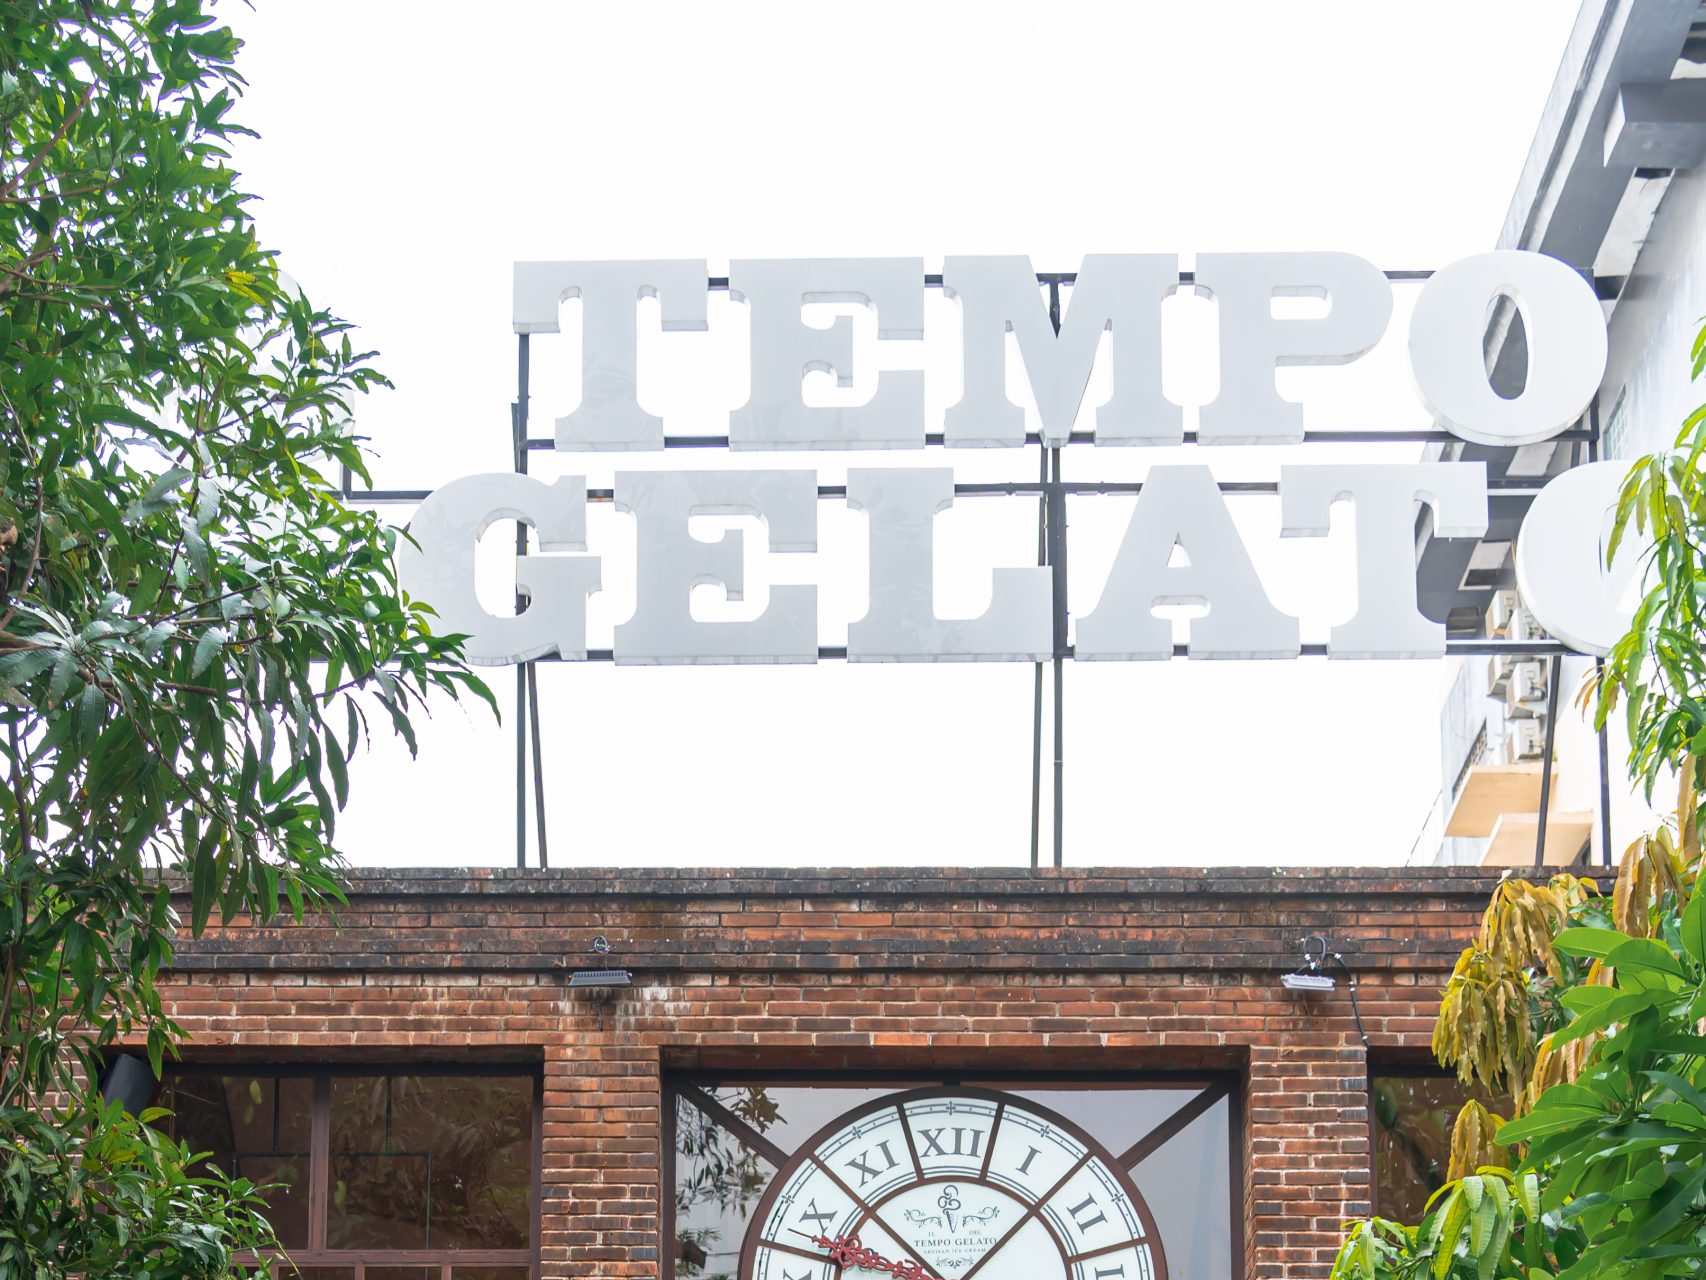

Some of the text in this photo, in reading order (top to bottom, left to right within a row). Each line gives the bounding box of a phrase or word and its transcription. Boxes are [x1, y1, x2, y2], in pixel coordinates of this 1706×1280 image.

[511, 249, 1609, 453] TEMPO
[917, 1127, 985, 1159] XII
[1015, 1145, 1043, 1176] I
[845, 1139, 900, 1189] XI
[799, 1197, 839, 1237] X
[1065, 1192, 1108, 1236] II
[913, 1237, 998, 1248] TEMPO GELATO
